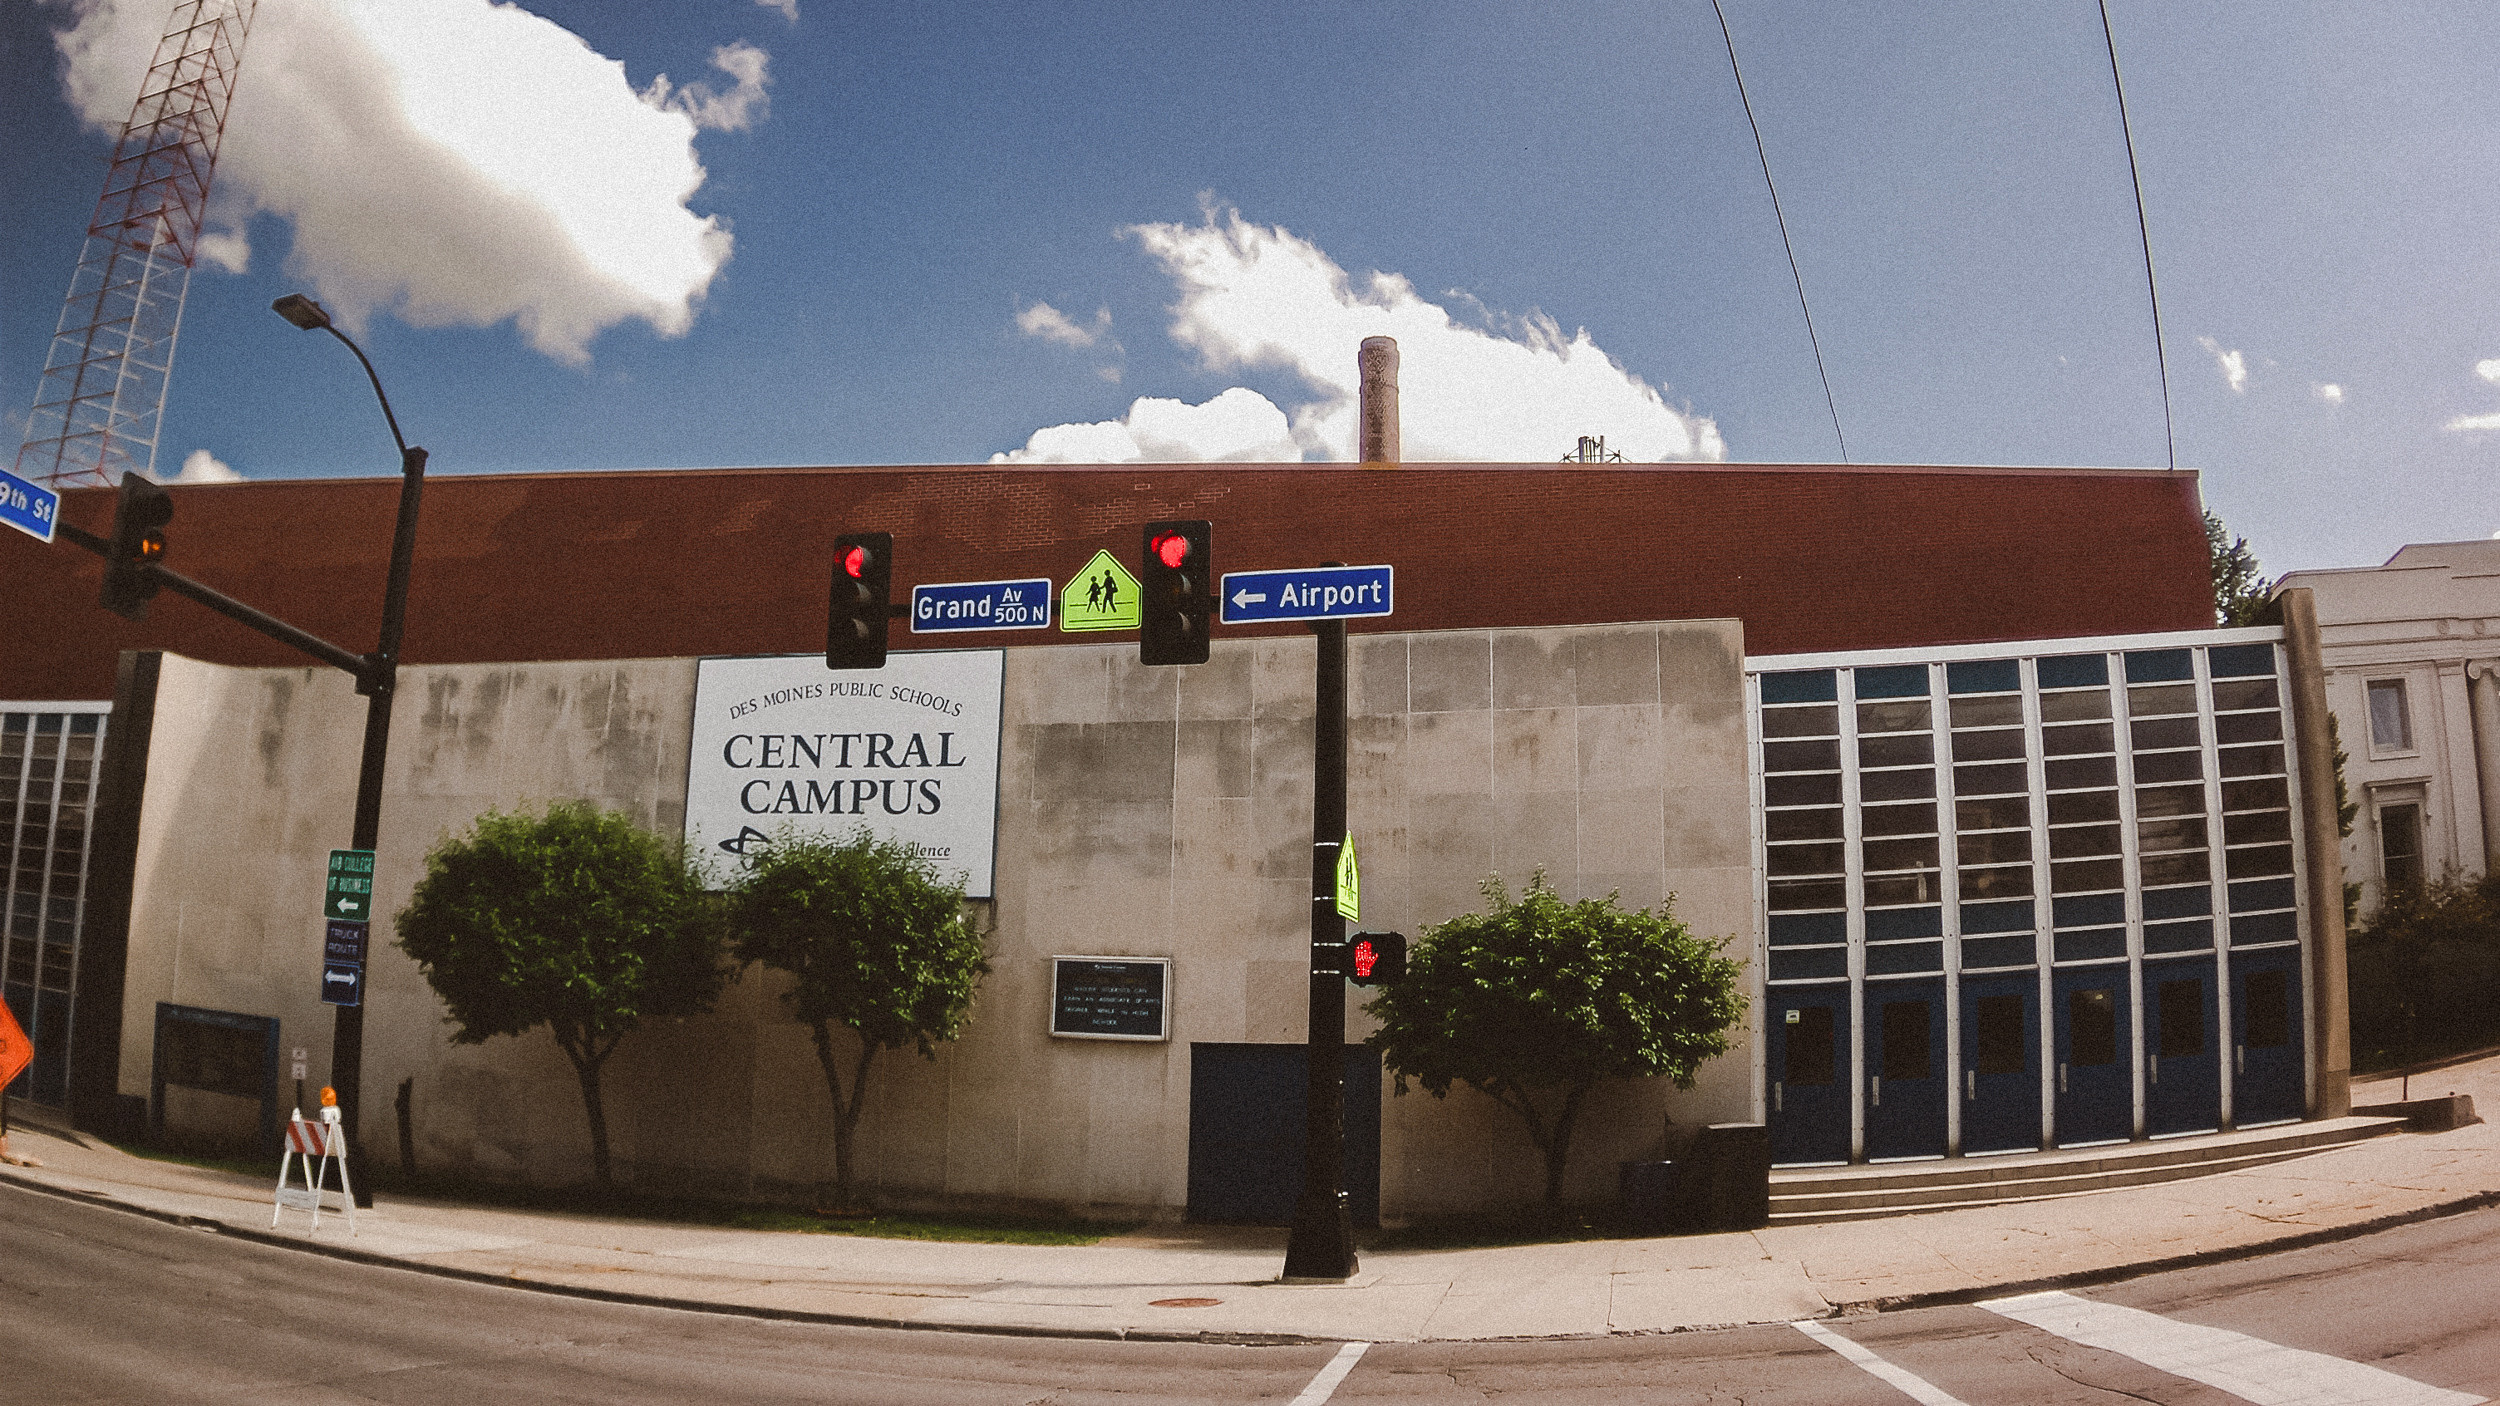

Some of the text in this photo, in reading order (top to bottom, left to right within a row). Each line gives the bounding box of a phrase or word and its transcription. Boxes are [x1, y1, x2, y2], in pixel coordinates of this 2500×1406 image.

[32, 498, 51, 523] St
[918, 587, 1023, 620] Grand Av
[1279, 579, 1382, 612] Airport
[994, 604, 1044, 624] 500 N
[729, 682, 963, 720] DES MOINES PUBLIC SCHOOLS
[723, 732, 967, 769] CENTRAL
[740, 778, 942, 815] CAMPUS
[328, 942, 358, 956] ROUTE
[331, 928, 359, 940] TRUCK
